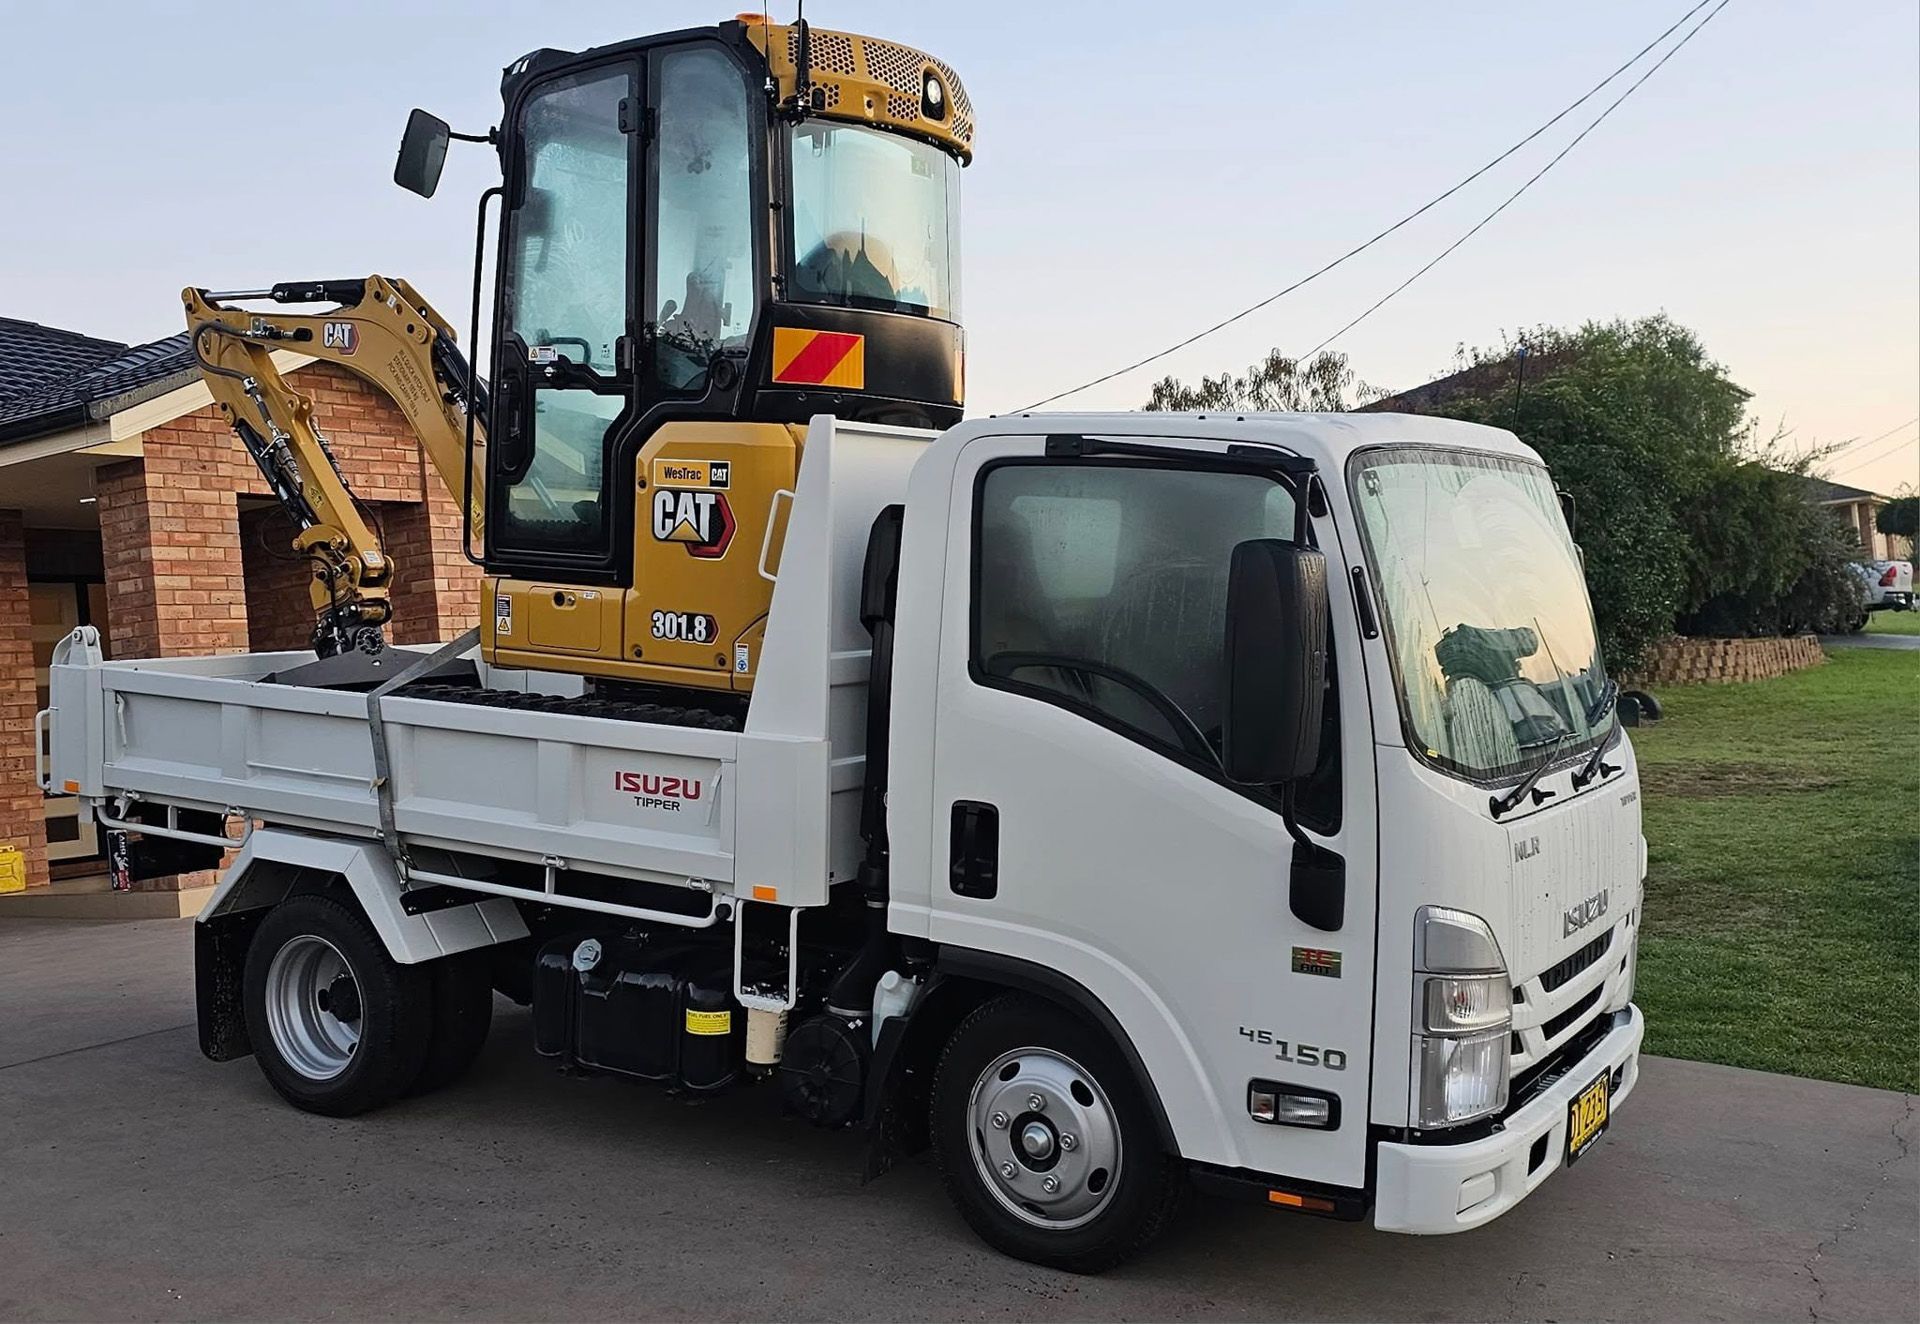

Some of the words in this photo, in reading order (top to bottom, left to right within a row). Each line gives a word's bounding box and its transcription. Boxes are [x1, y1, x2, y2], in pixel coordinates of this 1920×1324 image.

[323, 322, 352, 348] CAT
[664, 467, 702, 480] WesTrac
[711, 467, 728, 481] CAT
[653, 490, 716, 542] CAT
[652, 611, 707, 641] 301.8
[615, 771, 701, 800] ISUZU
[634, 796, 681, 812] TIPPER
[1514, 836, 1540, 863] NLR
[1563, 888, 1609, 939] ISUZU
[1239, 1026, 1273, 1045] 45
[1275, 1040, 1347, 1071] 150
